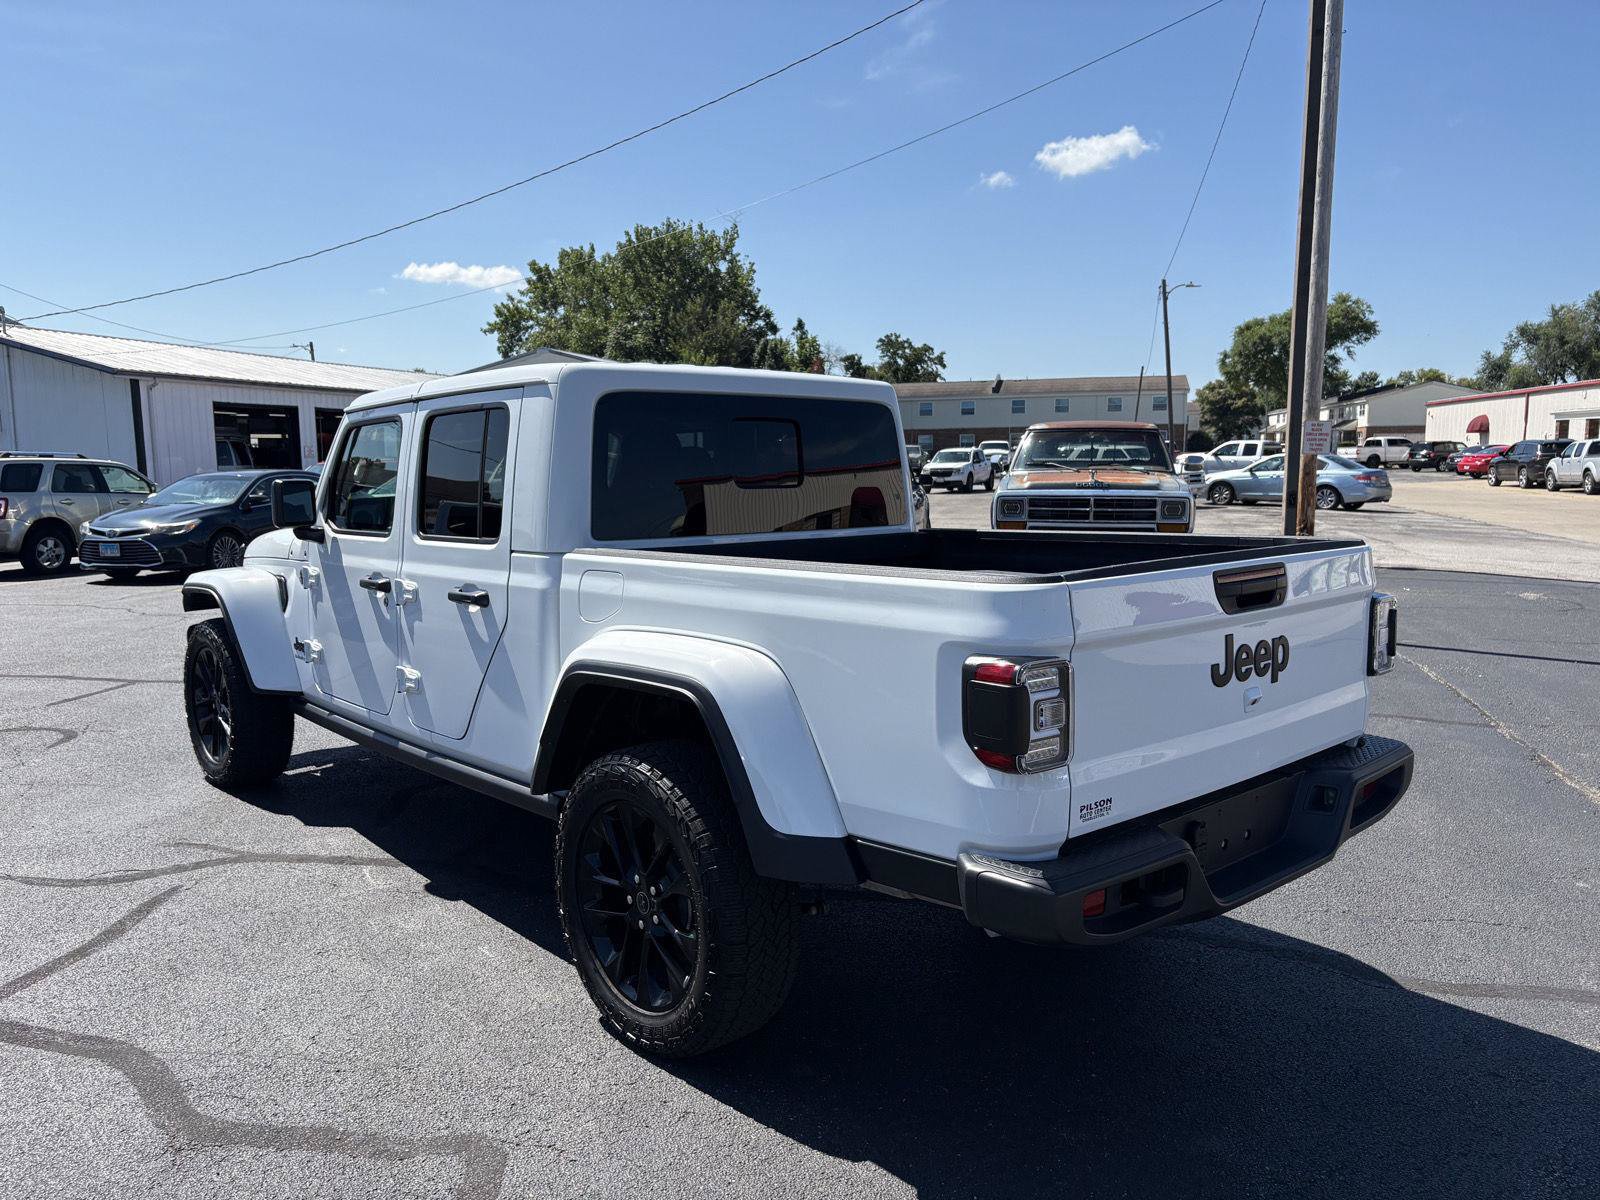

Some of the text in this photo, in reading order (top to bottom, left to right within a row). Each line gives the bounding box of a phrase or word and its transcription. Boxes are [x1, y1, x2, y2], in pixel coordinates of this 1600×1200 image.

[1210, 633, 1290, 688] Jeep
[1080, 797, 1112, 813] PILSON
[1080, 811, 1093, 820] AUTO
[1094, 805, 1111, 814] CENTER
